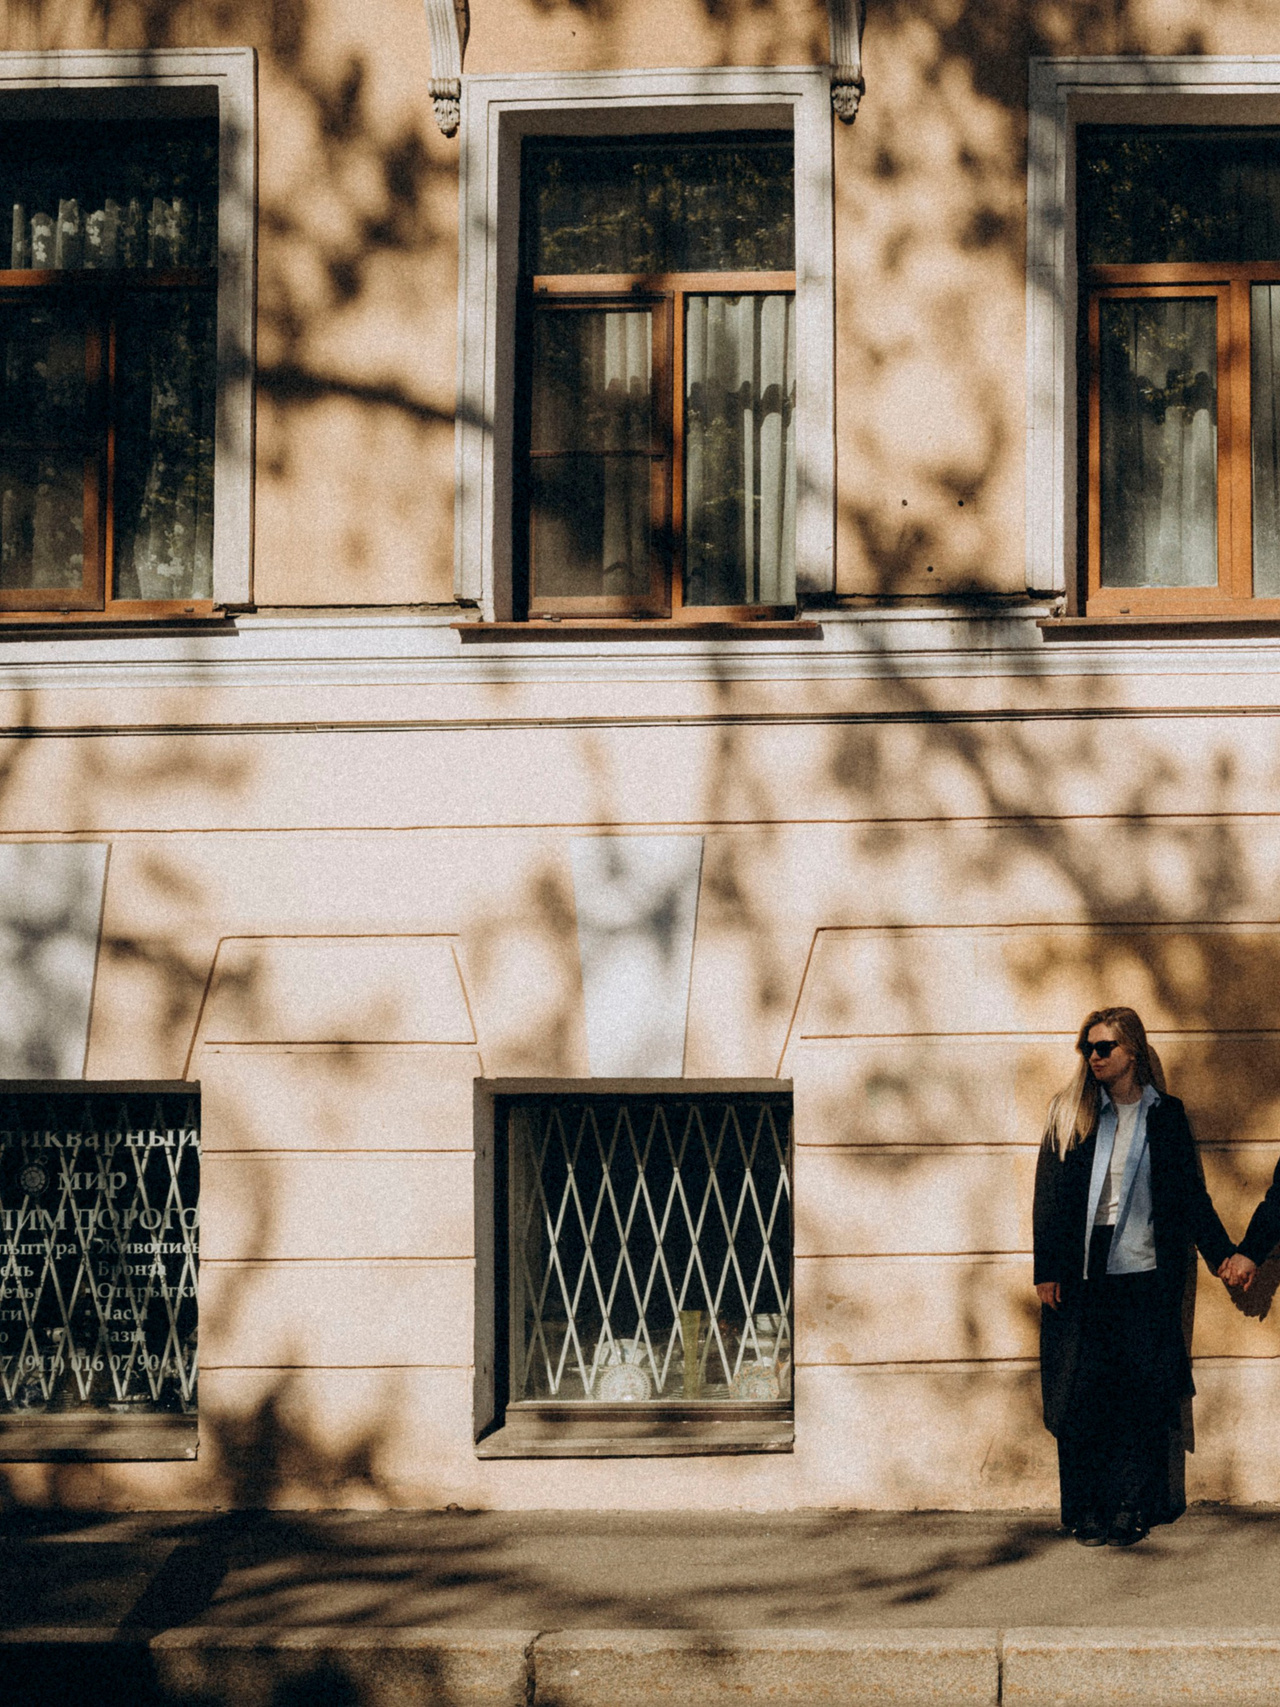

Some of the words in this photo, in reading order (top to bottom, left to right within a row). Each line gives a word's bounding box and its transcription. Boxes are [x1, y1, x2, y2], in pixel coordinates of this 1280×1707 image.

[57, 1171, 127, 1199] мир
[74, 1207, 200, 1236] ДОРОГО
[98, 1261, 167, 1282] Бронза
